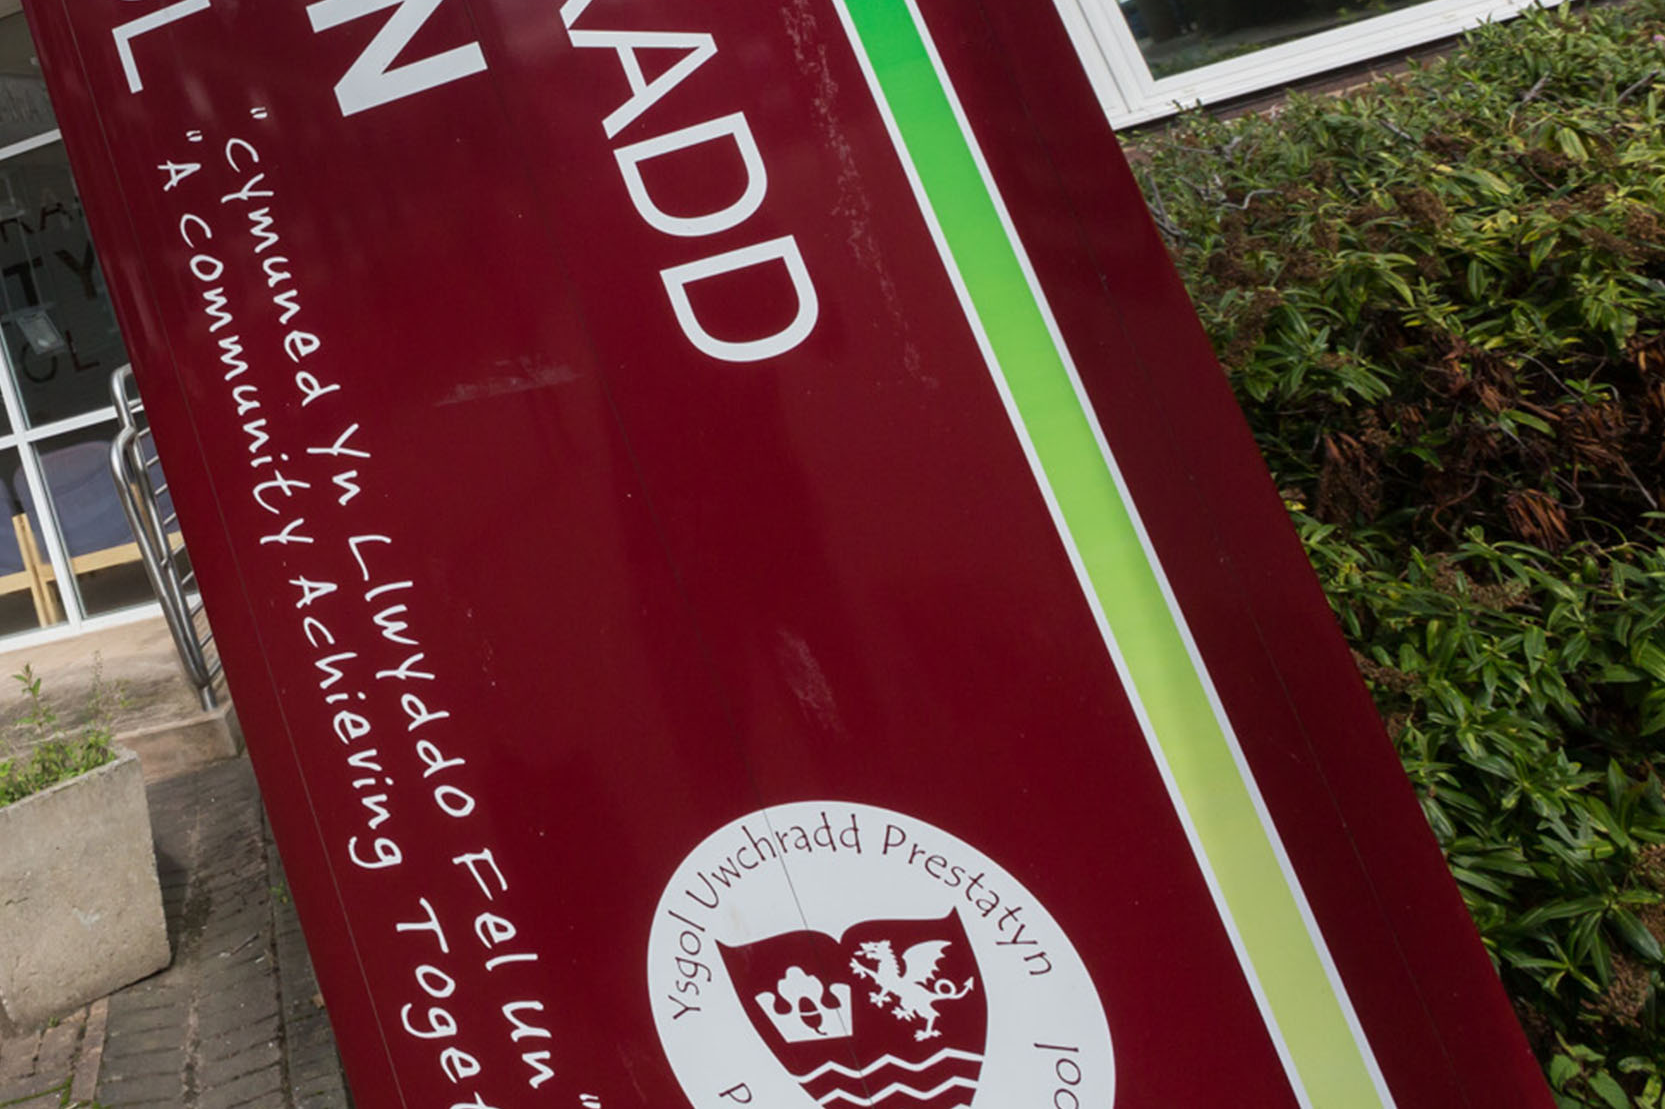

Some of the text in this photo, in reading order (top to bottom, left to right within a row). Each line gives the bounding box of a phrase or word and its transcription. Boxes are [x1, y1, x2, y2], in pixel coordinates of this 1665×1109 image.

[181, 214, 314, 545] Community
[290, 576, 402, 868] Achieving
[307, 424, 370, 505] Yn
[349, 535, 475, 818] Llwyddo
[453, 849, 537, 970] Fel
[667, 811, 1052, 1020] Ysgol Uwchradd Prestatyn
